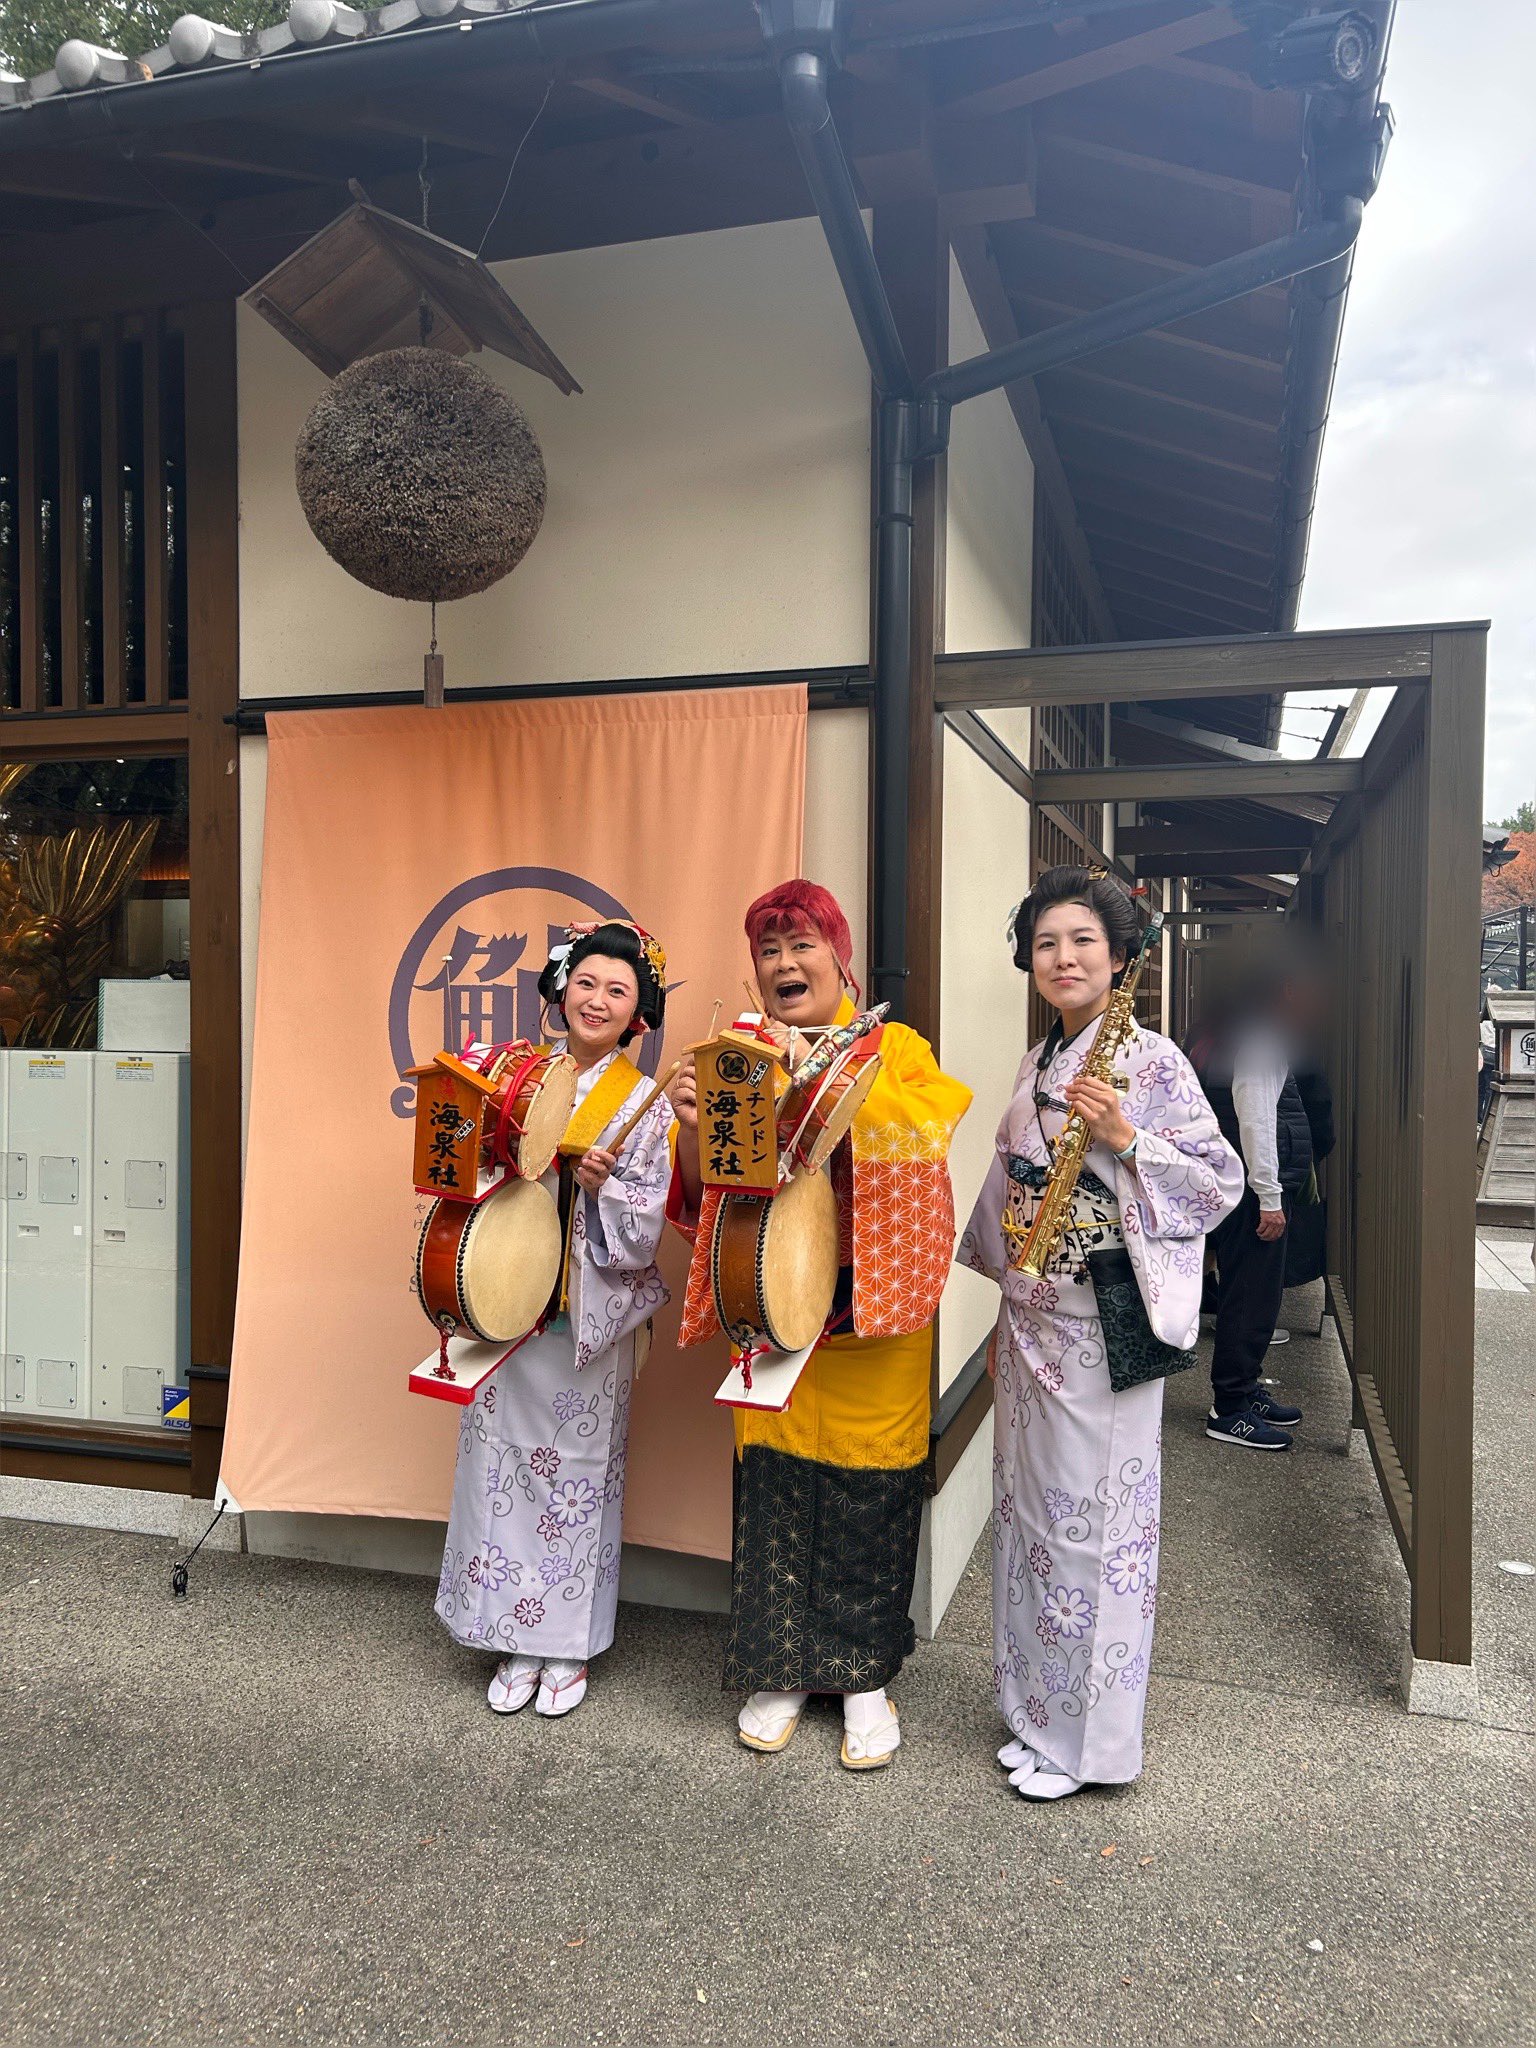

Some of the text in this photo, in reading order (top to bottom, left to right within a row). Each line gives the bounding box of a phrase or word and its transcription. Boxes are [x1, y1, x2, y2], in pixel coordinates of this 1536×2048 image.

[427, 1101, 463, 1188] 海泉社
[704, 1089, 745, 1177] 海泉社
[746, 1091, 768, 1164] チンドン
[1230, 1420, 1254, 1438] N
[1251, 1401, 1269, 1416] N
